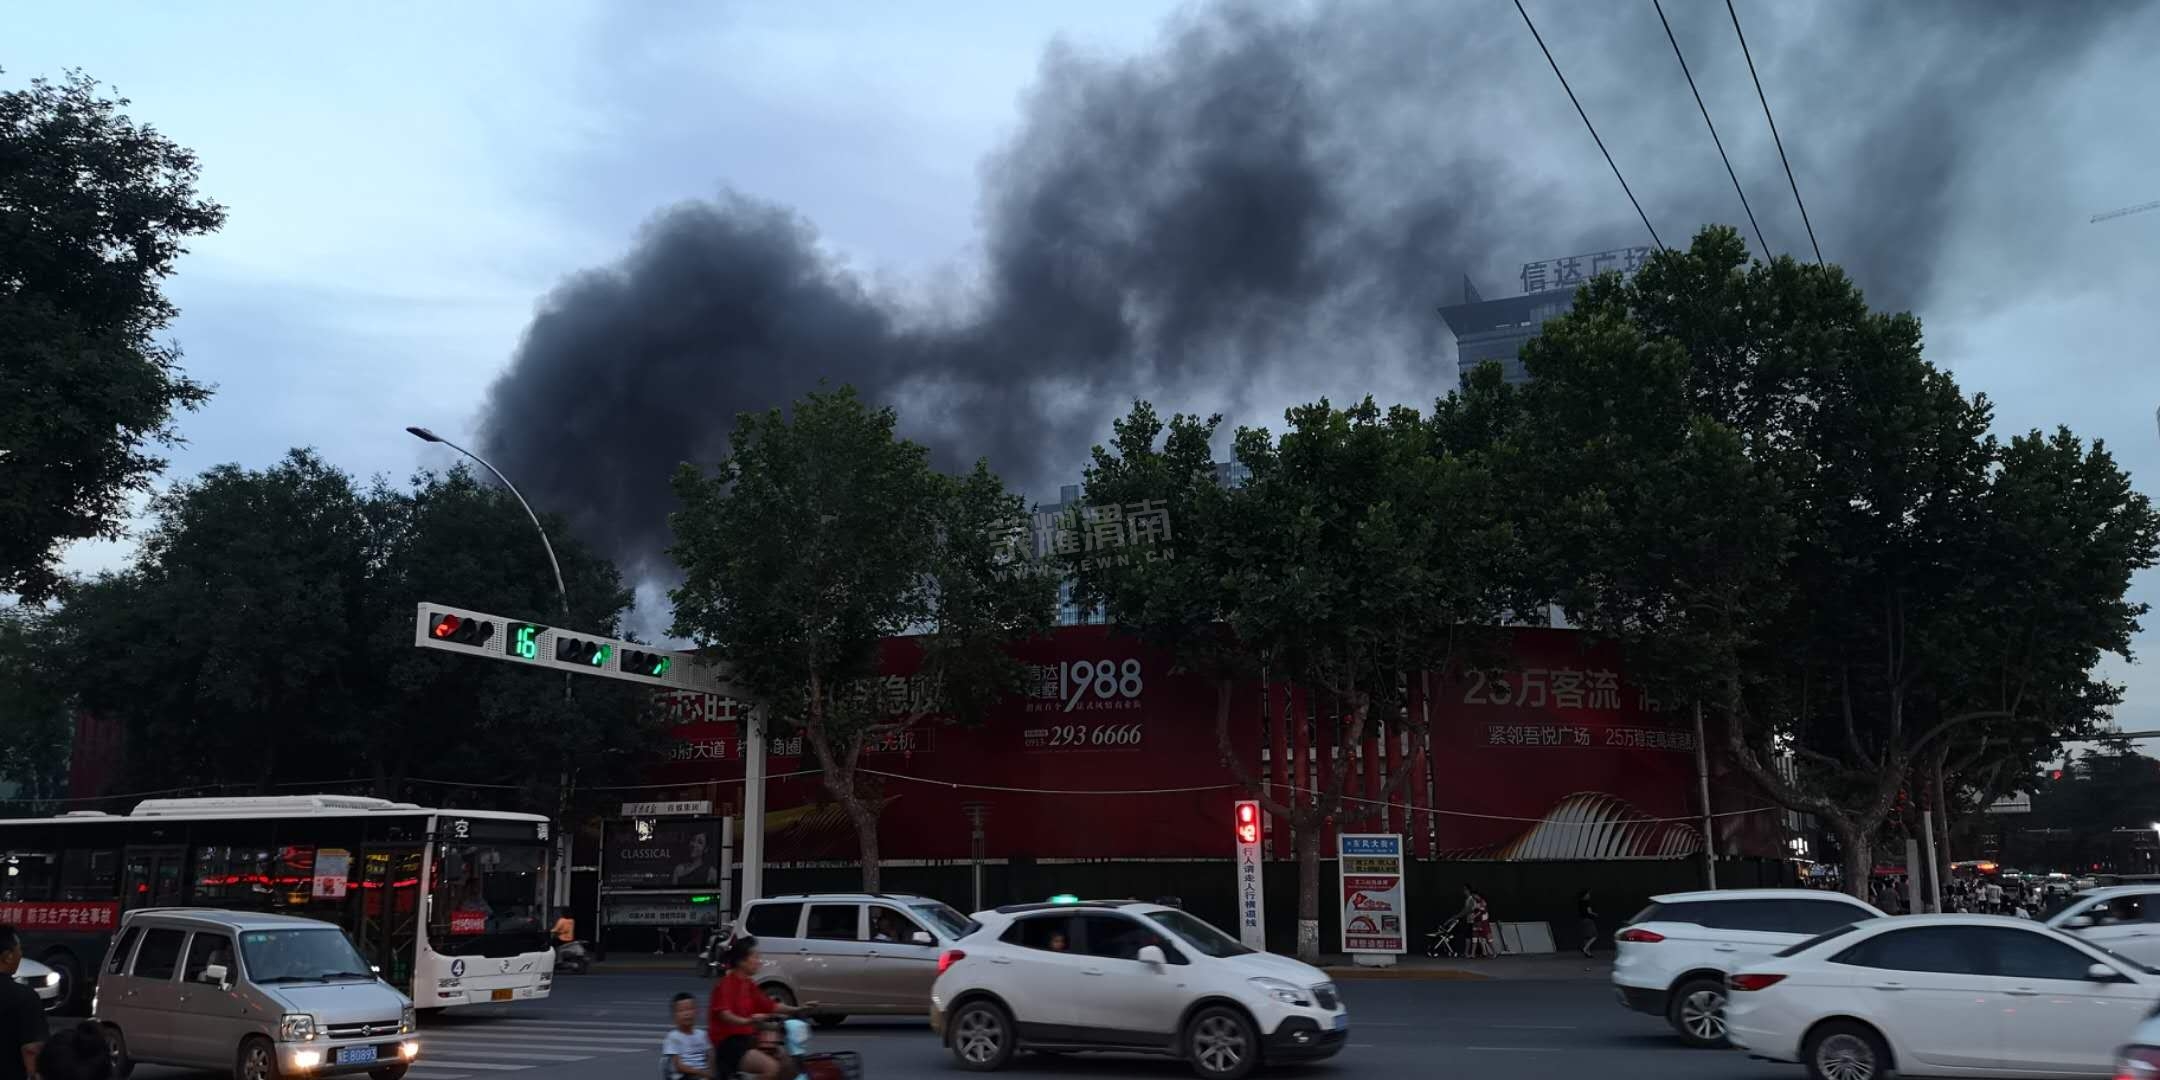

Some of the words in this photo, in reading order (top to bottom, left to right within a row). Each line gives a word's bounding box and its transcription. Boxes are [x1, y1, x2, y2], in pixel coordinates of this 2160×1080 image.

[1520, 247, 1650, 293] 信达广场
[517, 625, 537, 659] 16
[1060, 658, 1144, 713] 1988
[1463, 667, 1622, 709] 25万客流
[1048, 725, 1087, 746] 293
[1091, 724, 1142, 746] 6666
[1488, 726, 1591, 746] 紧邻吾悦广场
[620, 848, 671, 860] CLASSICAL
[1243, 847, 1258, 928] 行人请走人行横道线
[27, 907, 112, 925] 防范生产安全事故
